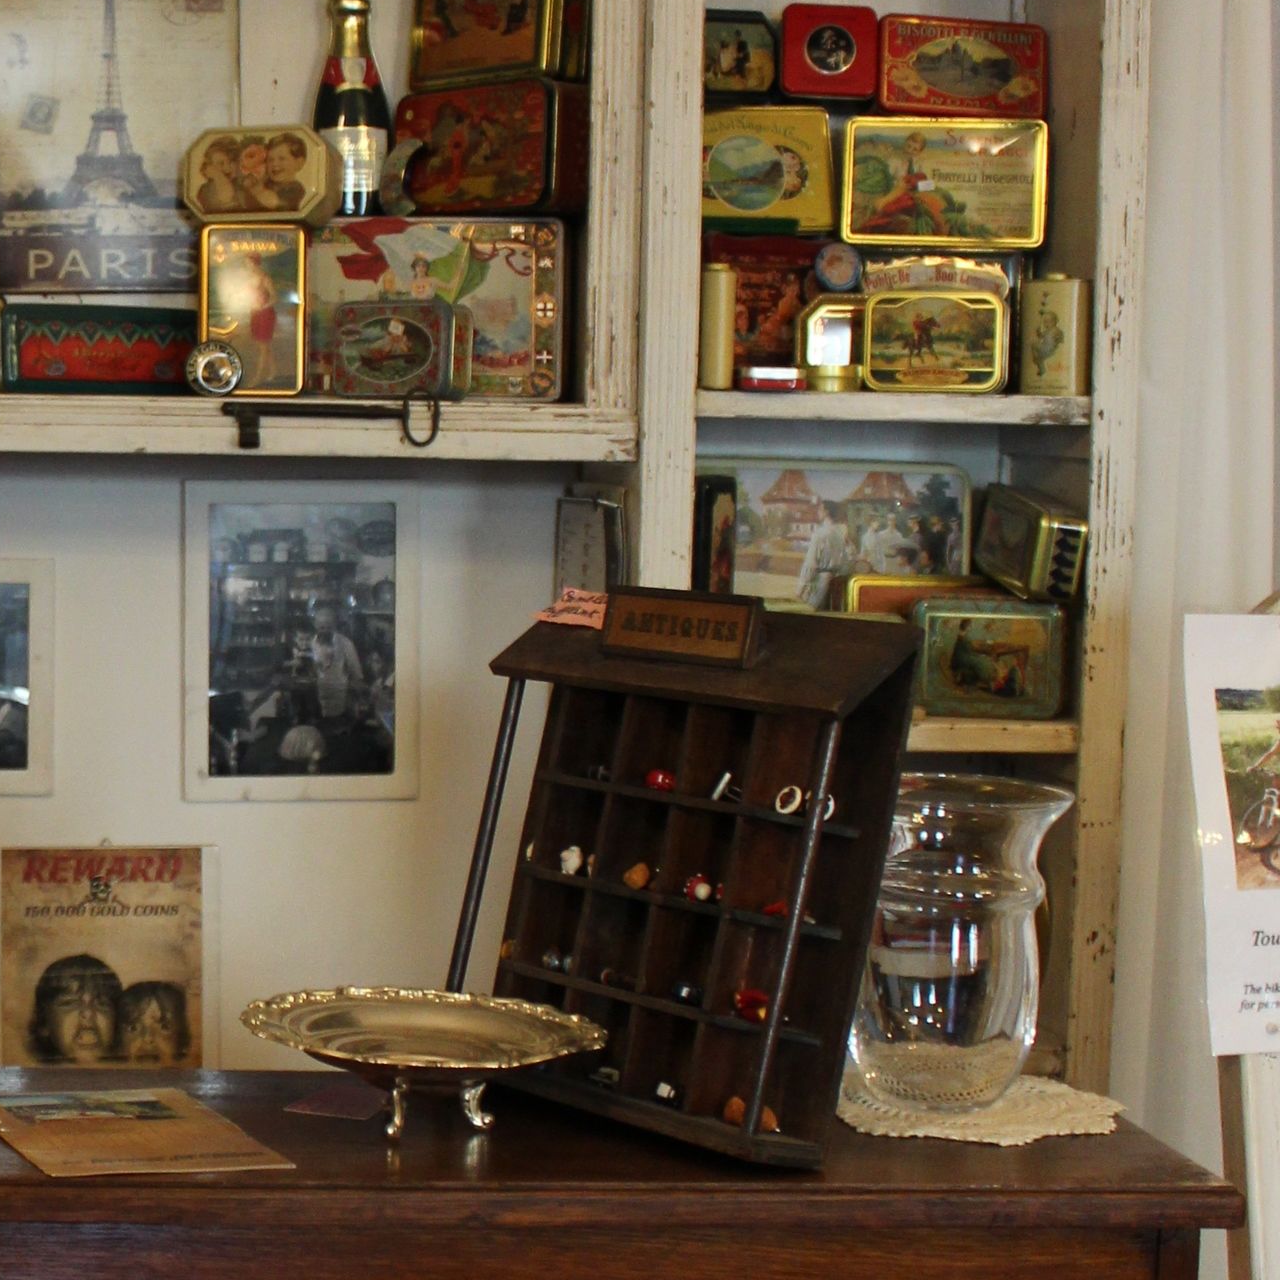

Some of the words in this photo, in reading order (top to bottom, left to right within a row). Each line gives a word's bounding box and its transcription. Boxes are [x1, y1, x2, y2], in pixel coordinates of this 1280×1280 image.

[27, 249, 198, 280] PARIS
[623, 612, 738, 641] ANTIQUES
[23, 855, 183, 884] REWARD
[89, 905, 130, 916] GOLD
[133, 905, 179, 916] COINS
[1243, 984, 1262, 995] The
[1239, 1000, 1256, 1012] for
